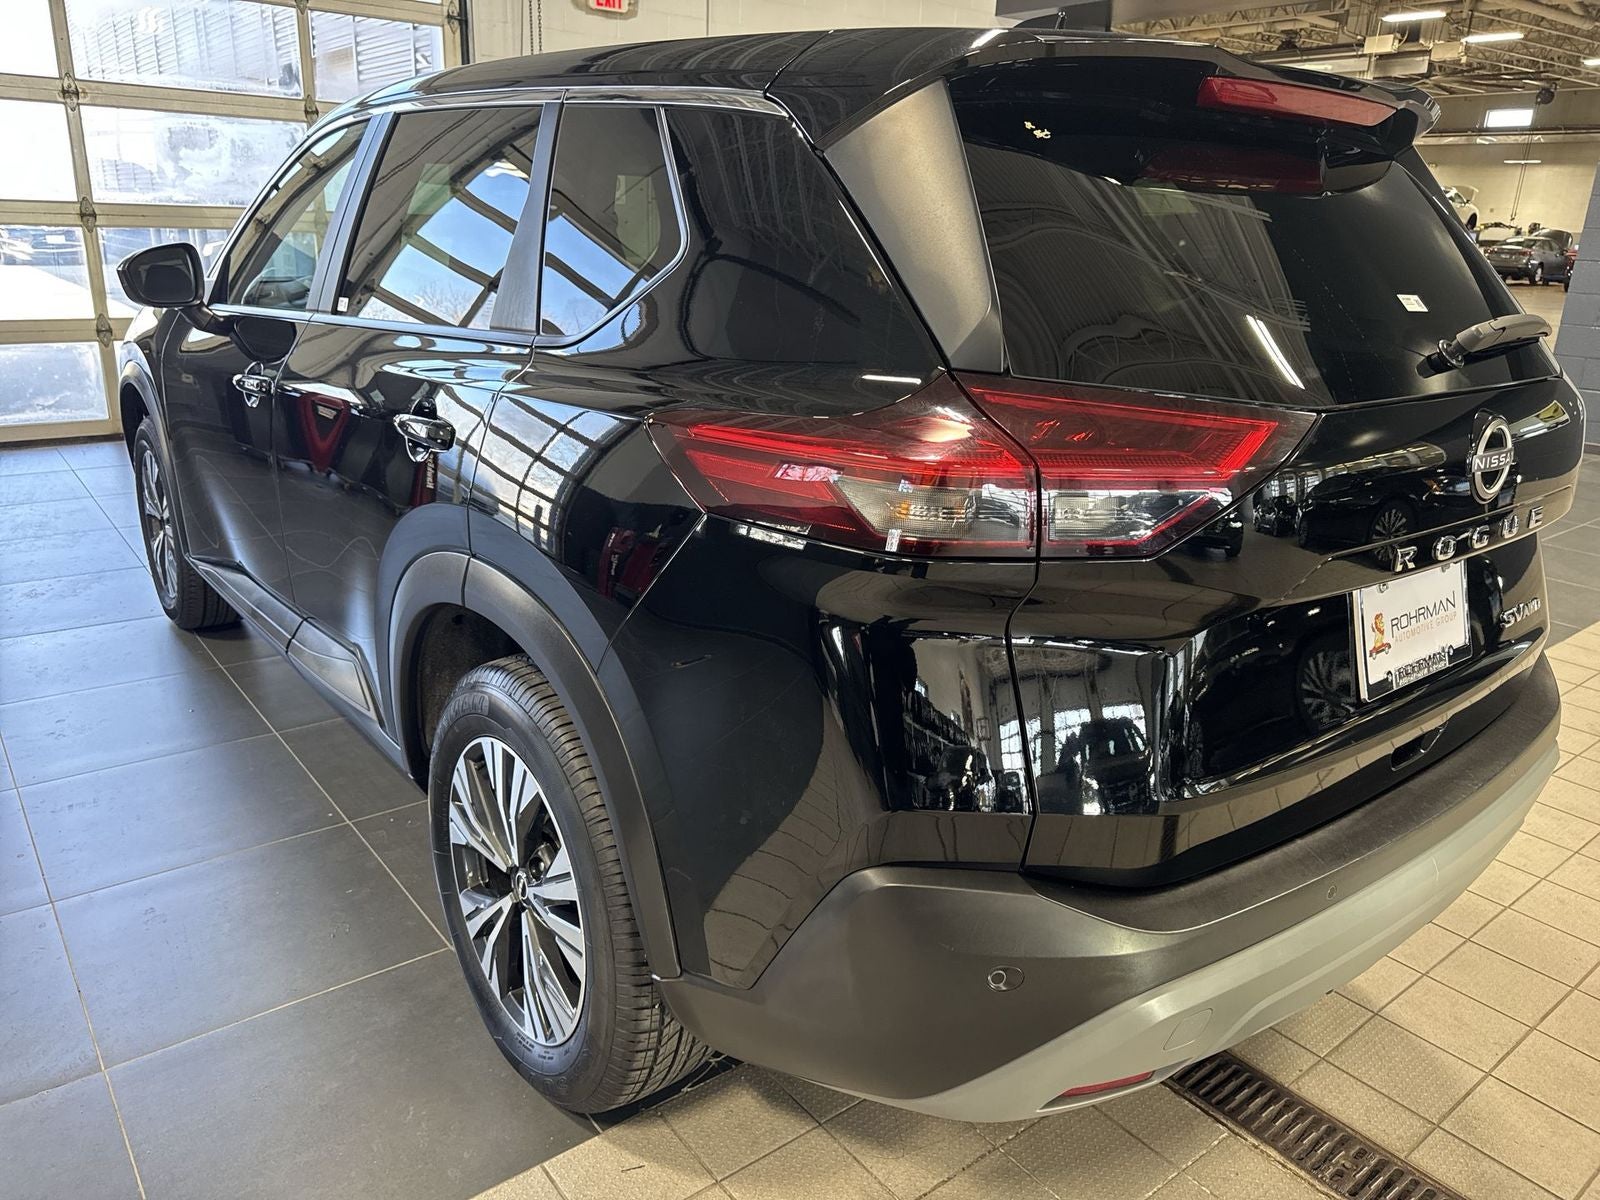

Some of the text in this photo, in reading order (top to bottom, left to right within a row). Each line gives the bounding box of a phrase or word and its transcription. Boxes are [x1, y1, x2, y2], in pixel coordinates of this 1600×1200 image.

[1392, 506, 1544, 572] ROGUE
[1390, 590, 1456, 638] ROHRMAN
[1394, 611, 1457, 643] AUTOMOTIVE GROUP
